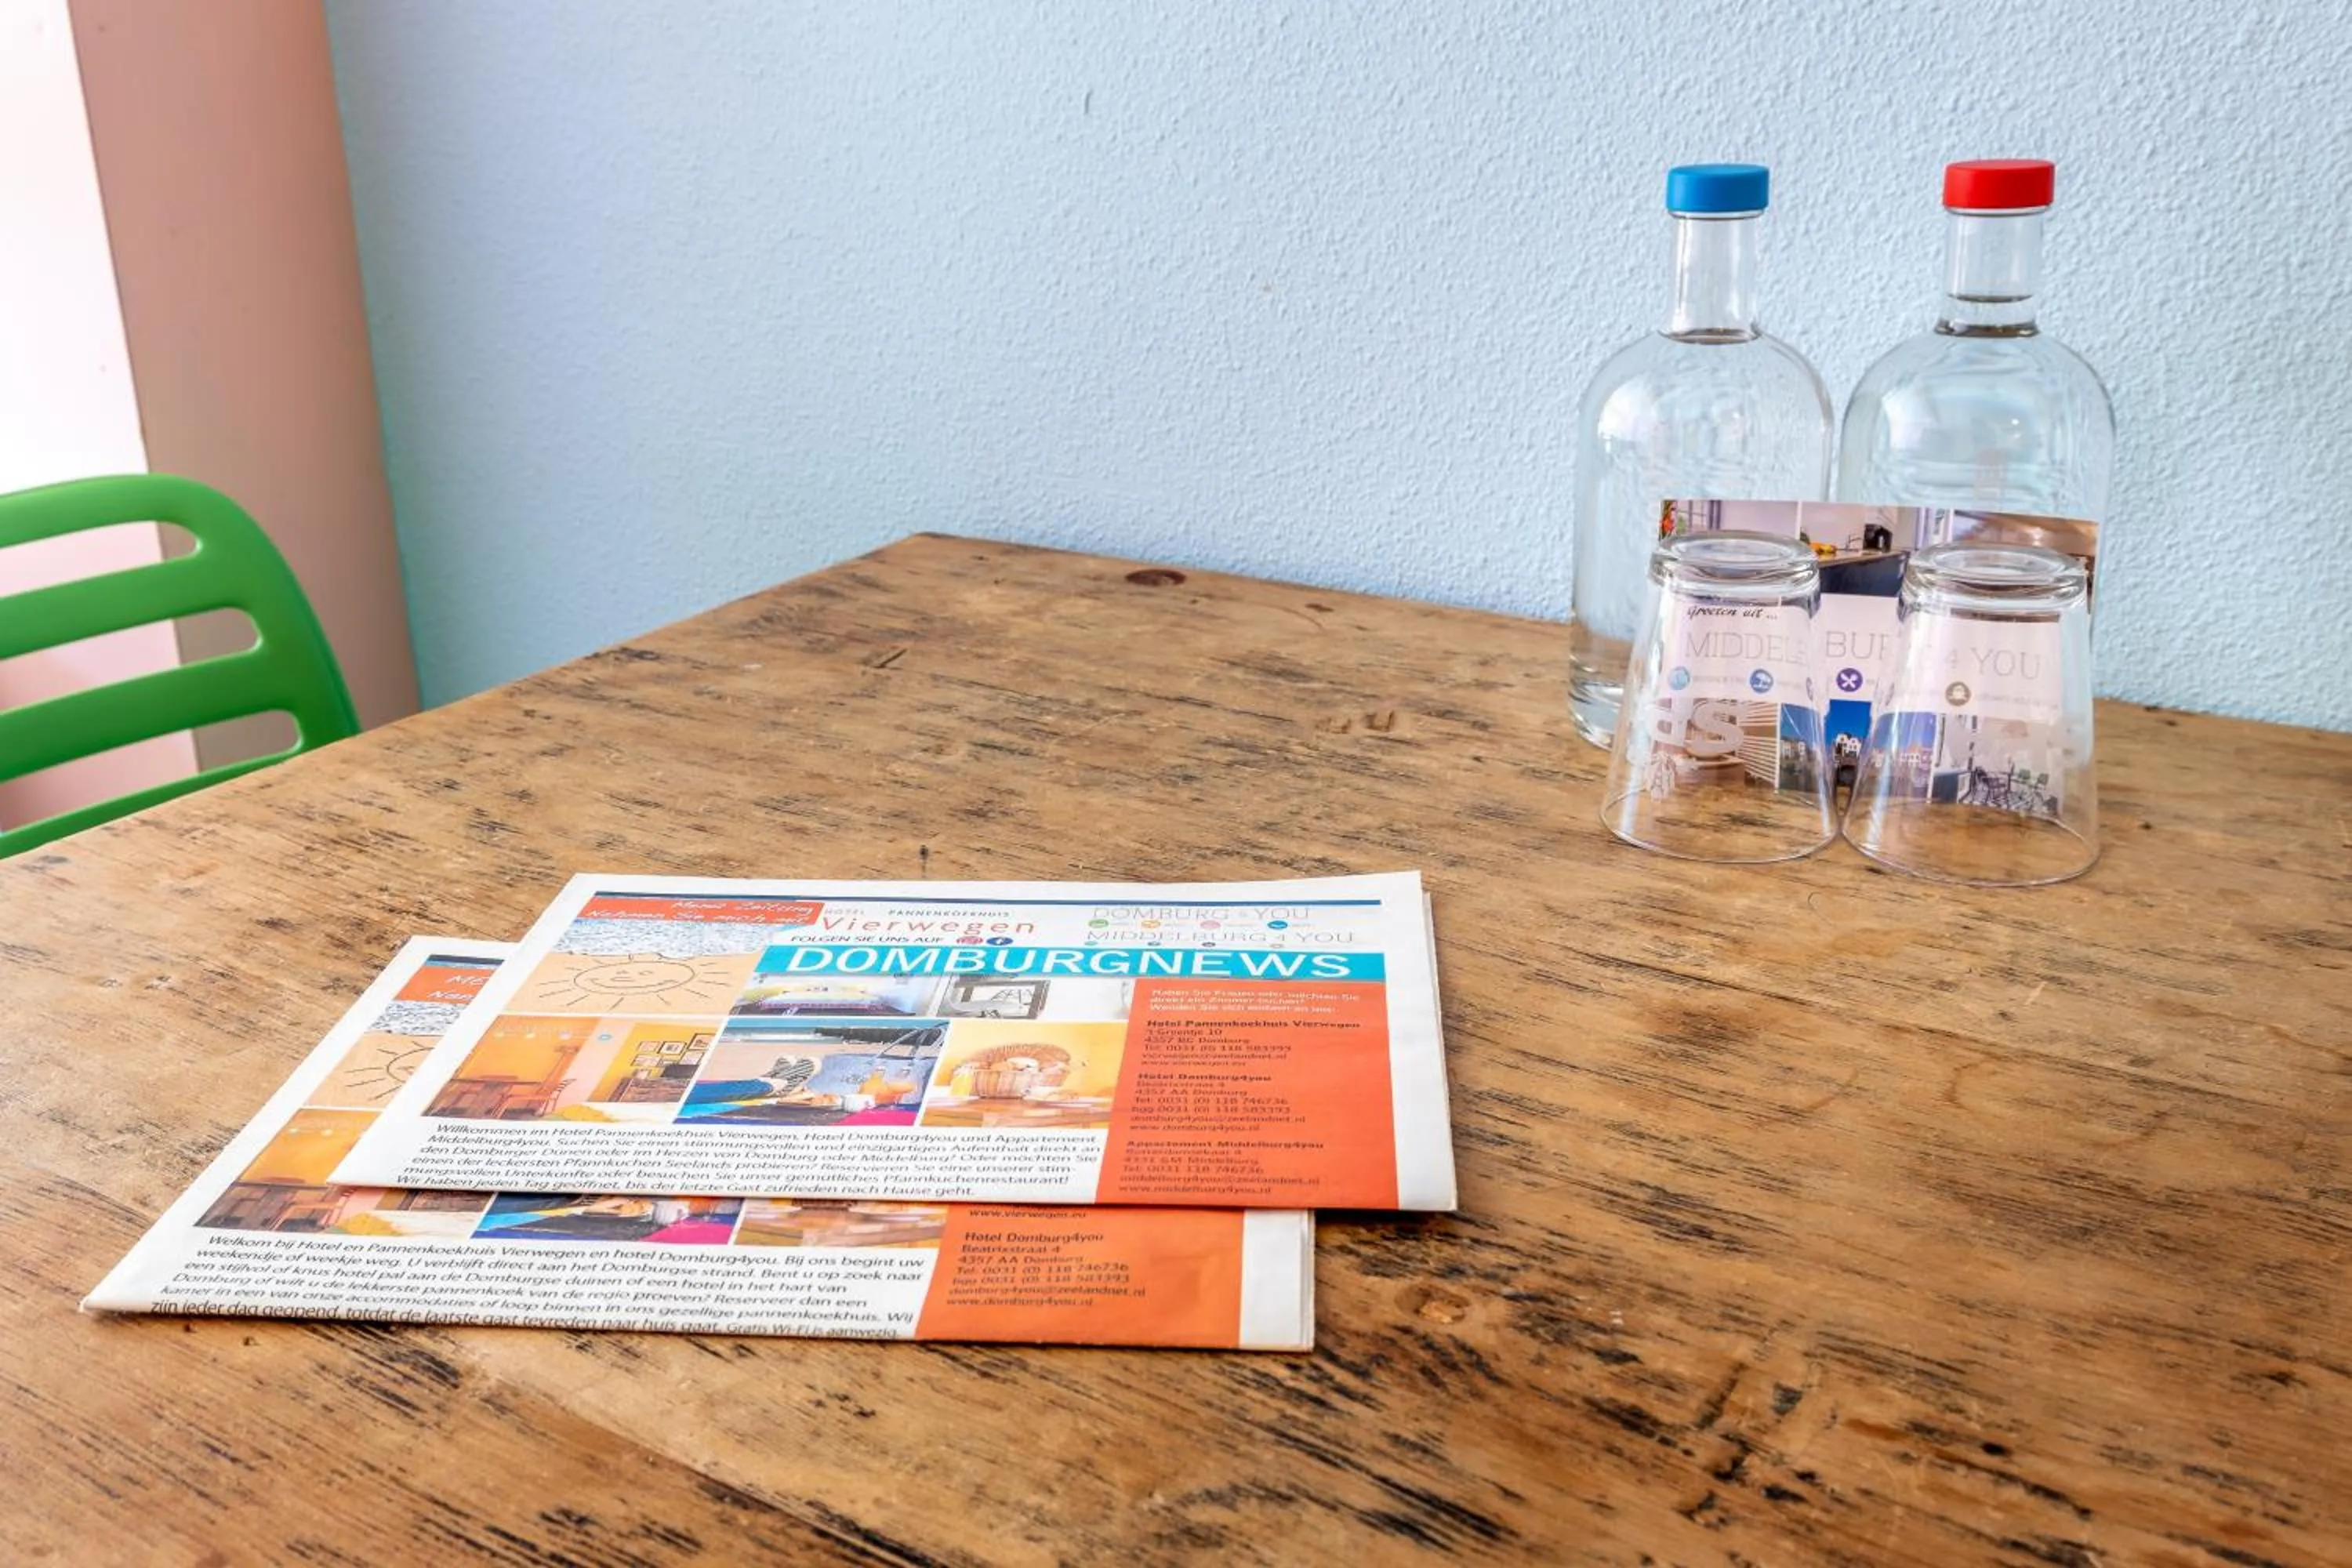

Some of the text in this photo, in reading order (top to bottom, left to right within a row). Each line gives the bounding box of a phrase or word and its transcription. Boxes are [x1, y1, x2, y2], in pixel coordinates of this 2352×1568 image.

[1971, 648, 2041, 681] YOU
[821, 916, 1035, 935] Vierwegen
[1092, 908, 1229, 920] DOMBURG
[1253, 908, 1310, 920] YOU
[1087, 931, 1266, 942] MIDDELBURG
[1294, 931, 1355, 942] YOU
[785, 947, 1352, 978] DOMBURGNEWS
[964, 1232, 1002, 1241] Hotel
[195, 1249, 284, 1262] weekendje
[304, 1254, 364, 1265] weekje
[423, 1258, 487, 1269] verblijft
[601, 1262, 699, 1276] Domburgse
[761, 1268, 800, 1277] Bent
[844, 1269, 884, 1279] zoek
[209, 1236, 273, 1246] Welkom
[299, 1240, 344, 1250] Hotel
[369, 1243, 498, 1254] Pannenkoekhuis
[499, 1247, 587, 1258] Vierwegen
[615, 1249, 657, 1259] hotel
[840, 1257, 897, 1268] begint
[172, 1273, 253, 1286] Domburg
[276, 1276, 309, 1286] wilt
[350, 1279, 423, 1290] lekkerste
[423, 1283, 527, 1298] pannenkoek
[586, 1289, 632, 1301] regio
[714, 1294, 797, 1303] Reserveer
[800, 1295, 833, 1305] dan
[218, 1262, 274, 1274] stijlvol
[295, 1265, 334, 1275] knus
[336, 1267, 379, 1277] hotel
[465, 1272, 563, 1286] Domburgse
[682, 1278, 726, 1288] hotel
[779, 1281, 815, 1291] hart
[304, 1291, 343, 1300] onze
[500, 1298, 541, 1312] loop
[544, 1301, 604, 1310] binnen
[659, 1305, 735, 1319] gezellige
